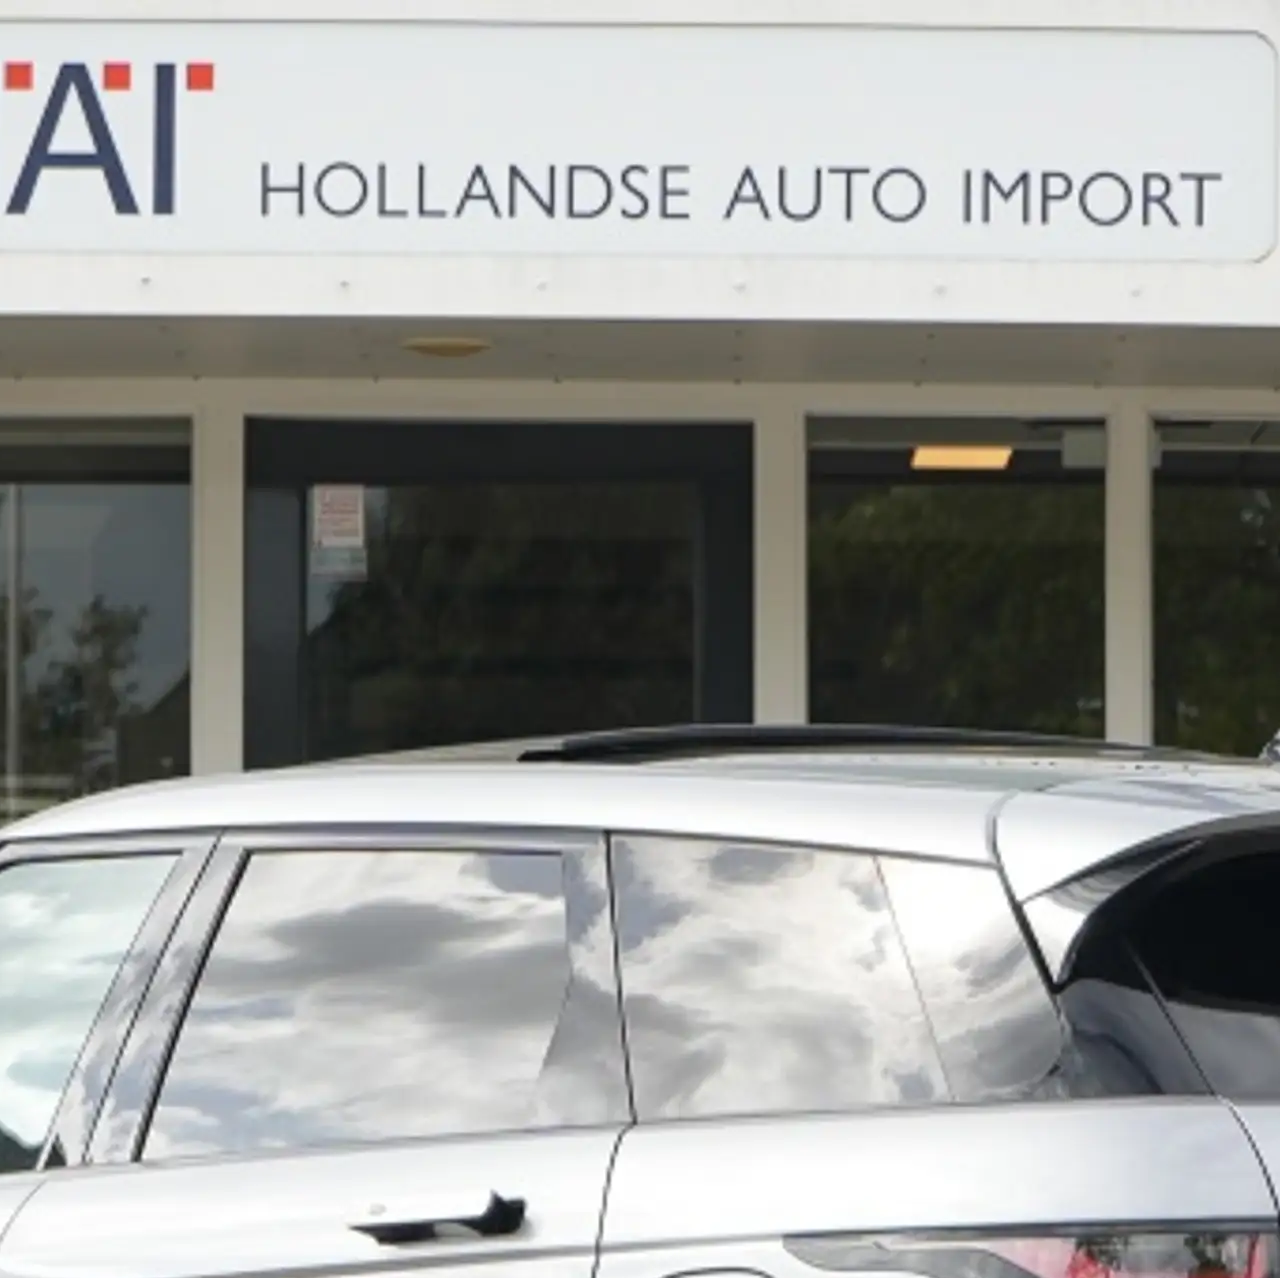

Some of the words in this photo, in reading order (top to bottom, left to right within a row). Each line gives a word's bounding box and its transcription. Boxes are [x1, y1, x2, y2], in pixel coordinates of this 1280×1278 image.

[260, 161, 690, 219] HOLLANDSE
[723, 166, 926, 222] AUTO
[963, 169, 1222, 226] IMPORT
